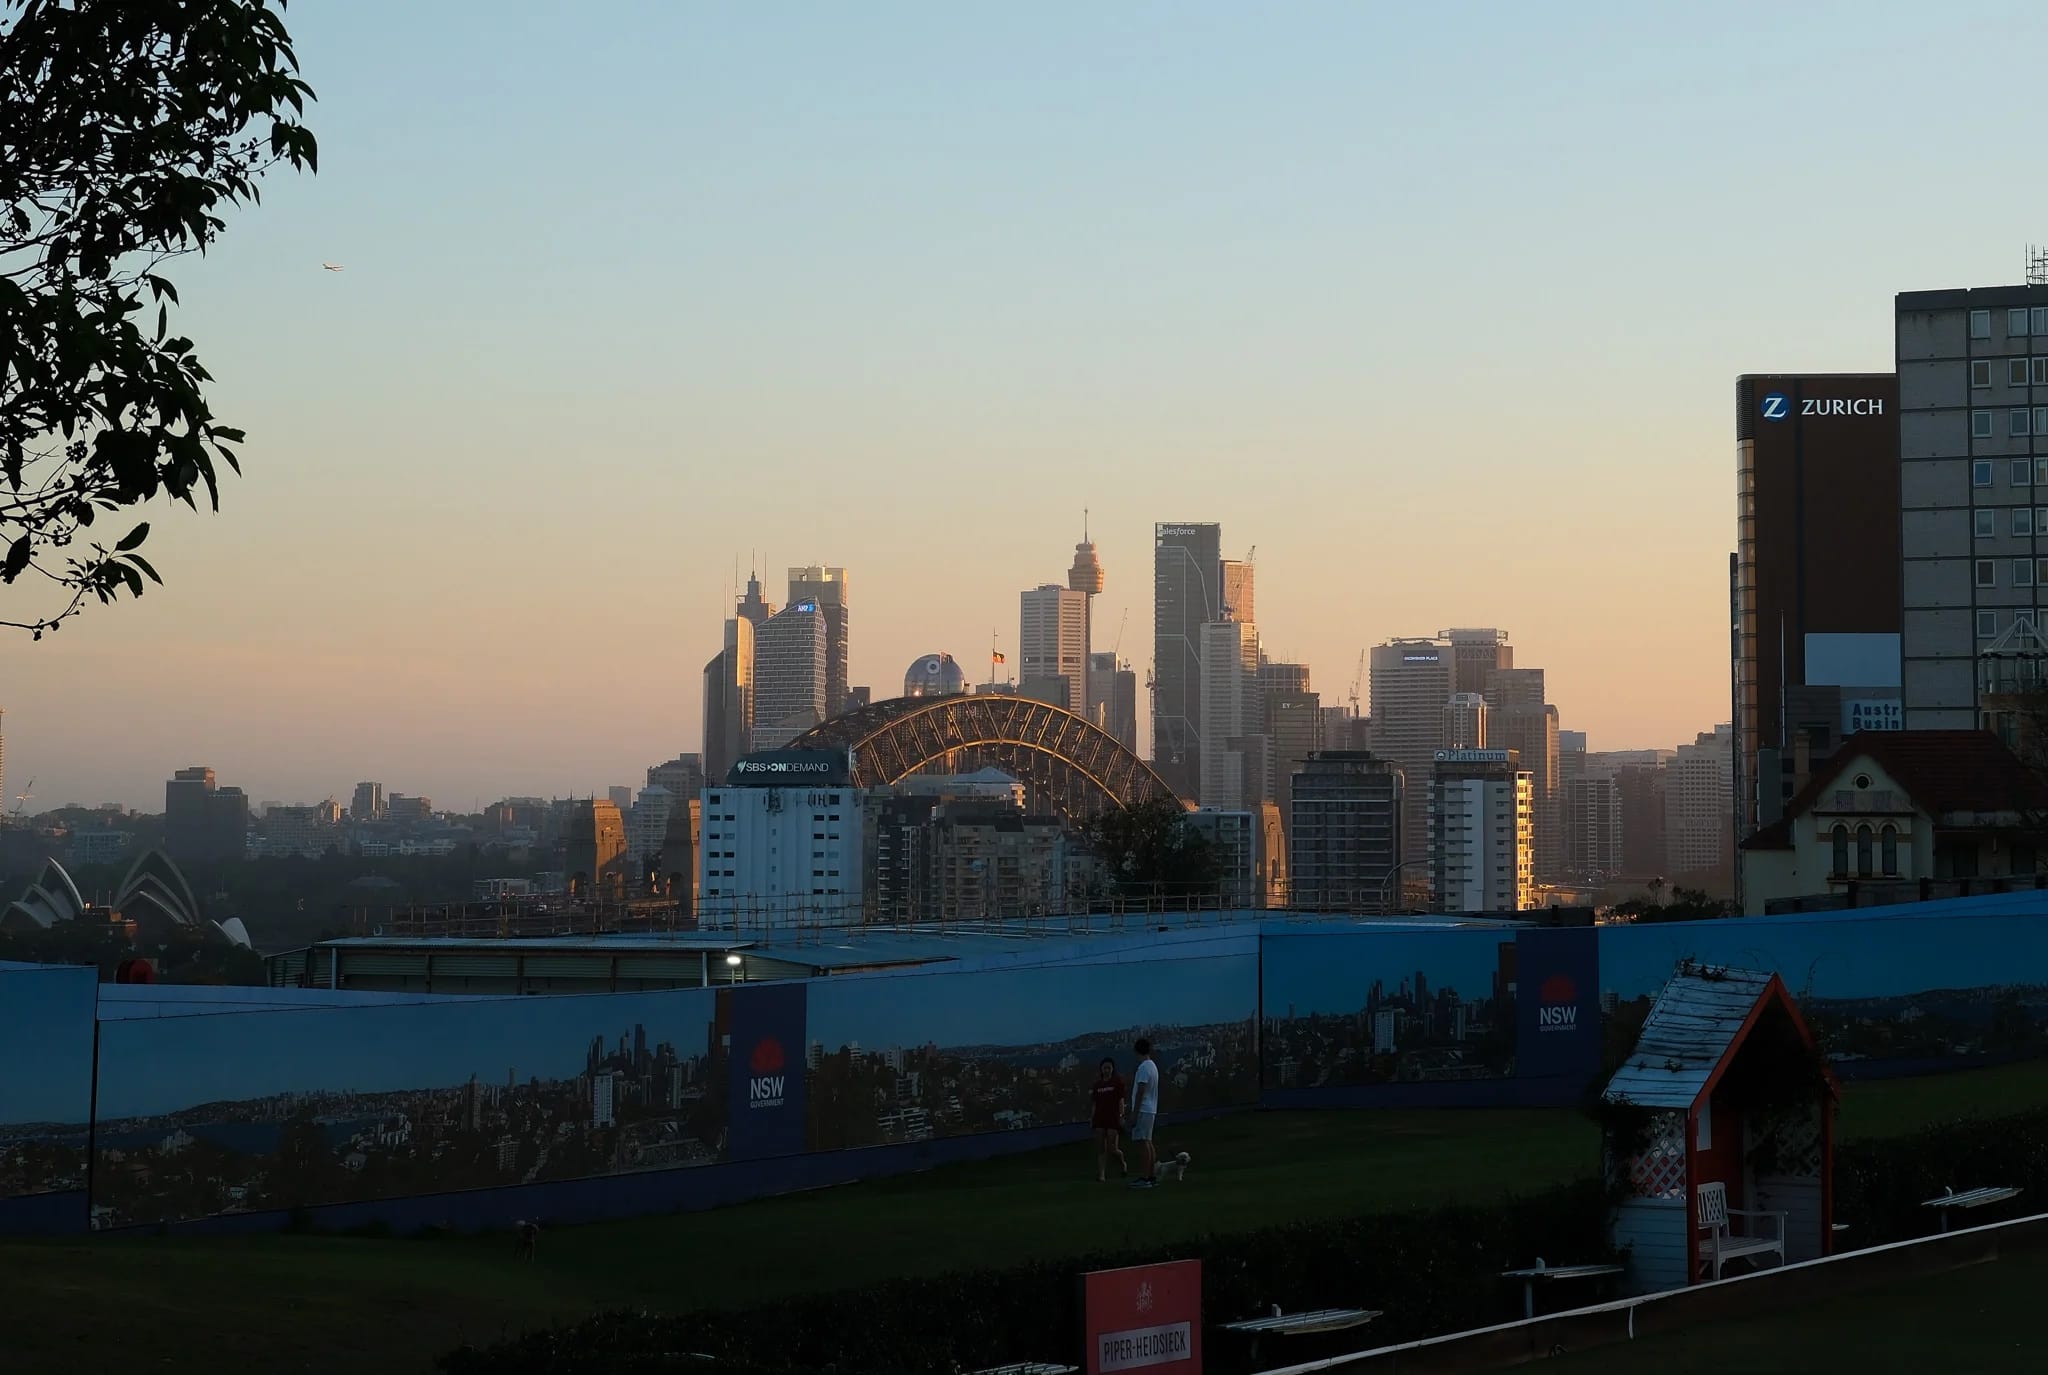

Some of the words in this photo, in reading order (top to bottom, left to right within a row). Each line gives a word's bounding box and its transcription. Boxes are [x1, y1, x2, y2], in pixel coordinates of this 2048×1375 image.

[1800, 399, 1883, 416] ZURICH
[1159, 527, 1196, 537] alesforce
[1448, 751, 1505, 761] Platinum
[745, 762, 767, 772] SBS
[1539, 1006, 1577, 1025] NSW
[750, 1075, 785, 1100] NSW
[1103, 1330, 1186, 1363] PIPER-HEIDSIECK
